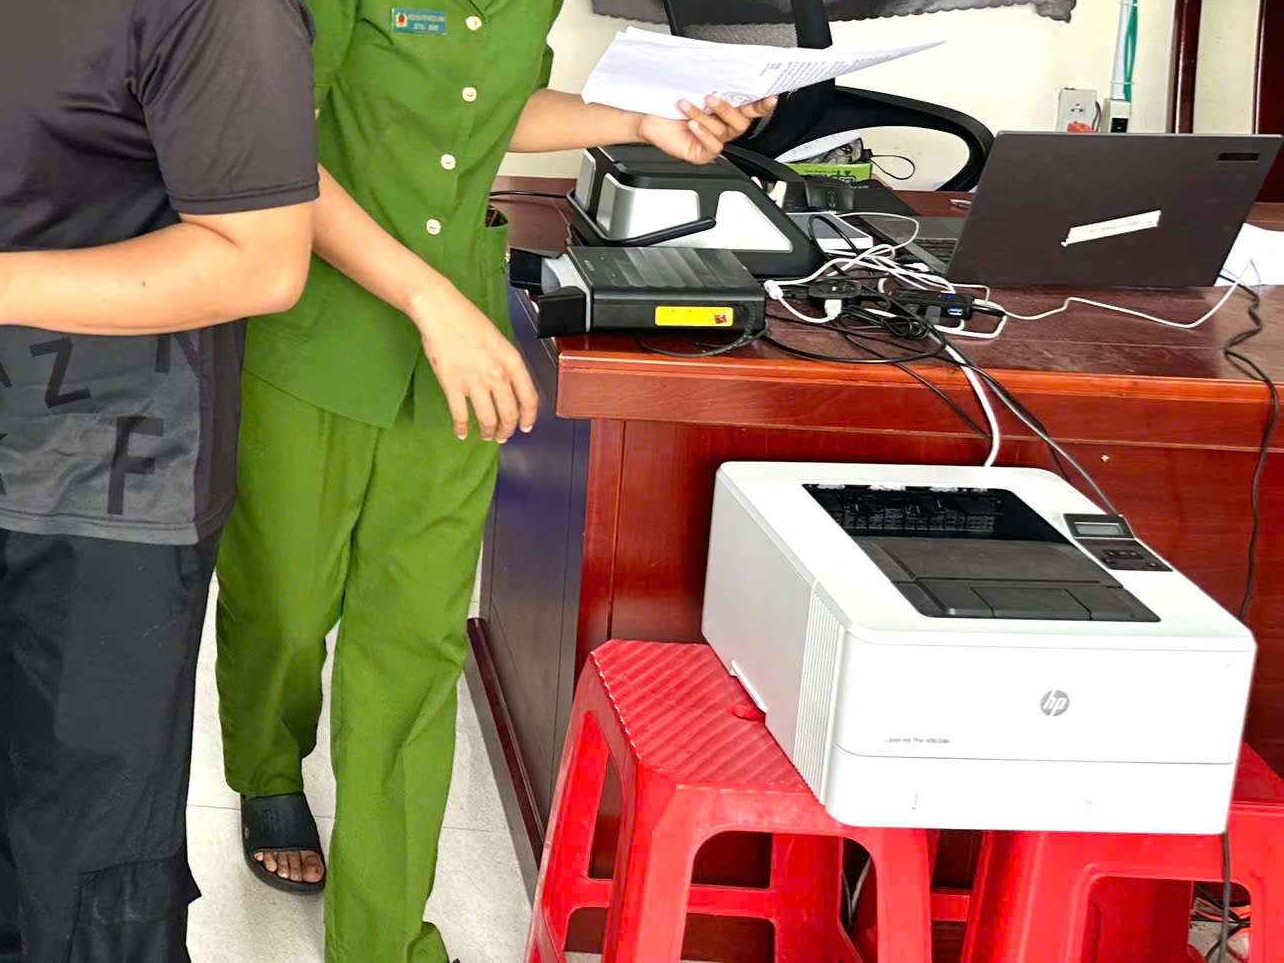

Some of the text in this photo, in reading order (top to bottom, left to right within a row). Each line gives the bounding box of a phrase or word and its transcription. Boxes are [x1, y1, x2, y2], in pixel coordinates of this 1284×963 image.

[30, 337, 91, 409] Z
[107, 415, 165, 516] F
[1039, 689, 1070, 718] hp
